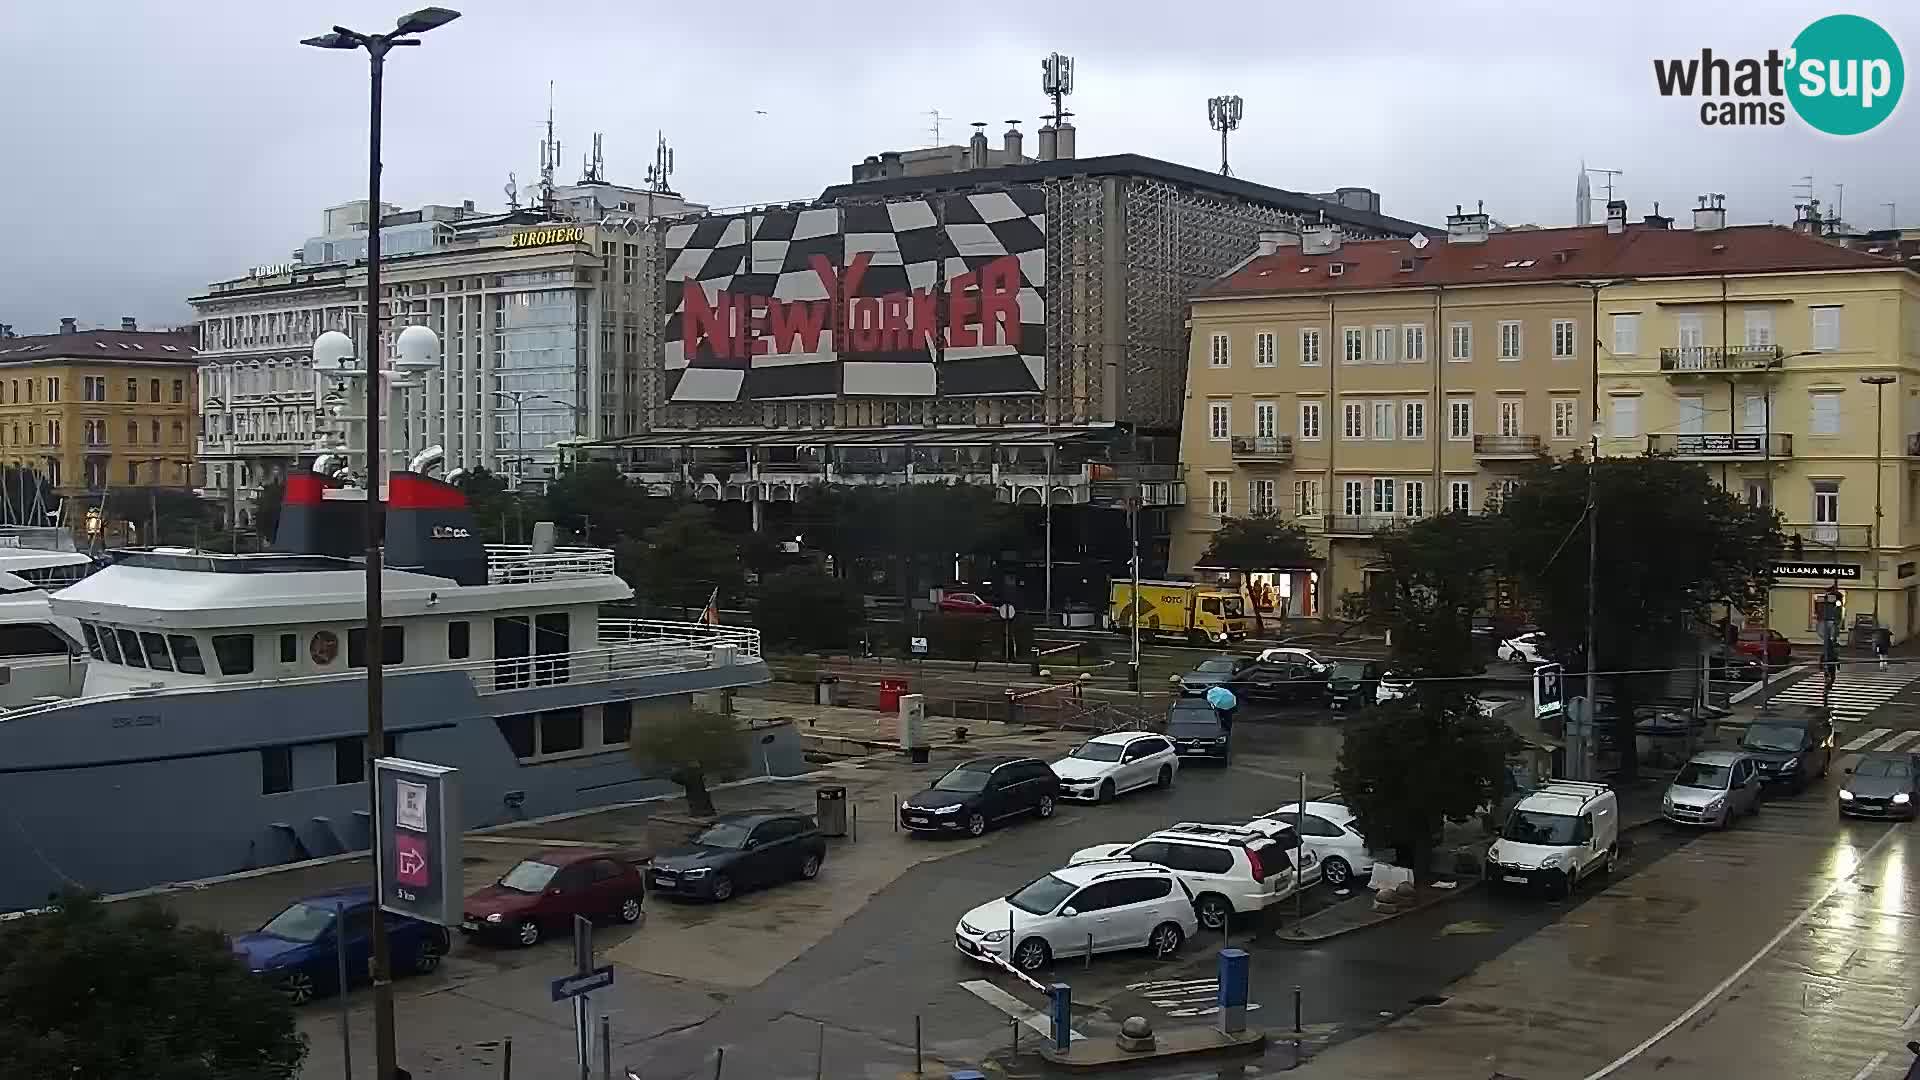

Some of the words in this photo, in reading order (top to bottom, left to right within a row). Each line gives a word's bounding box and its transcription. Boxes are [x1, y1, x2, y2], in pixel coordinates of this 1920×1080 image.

[809, 250, 1021, 353] YORKER
[1772, 566, 1819, 575] JULIANA
[1822, 567, 1856, 577] NAILS
[1544, 671, 1556, 695] P
